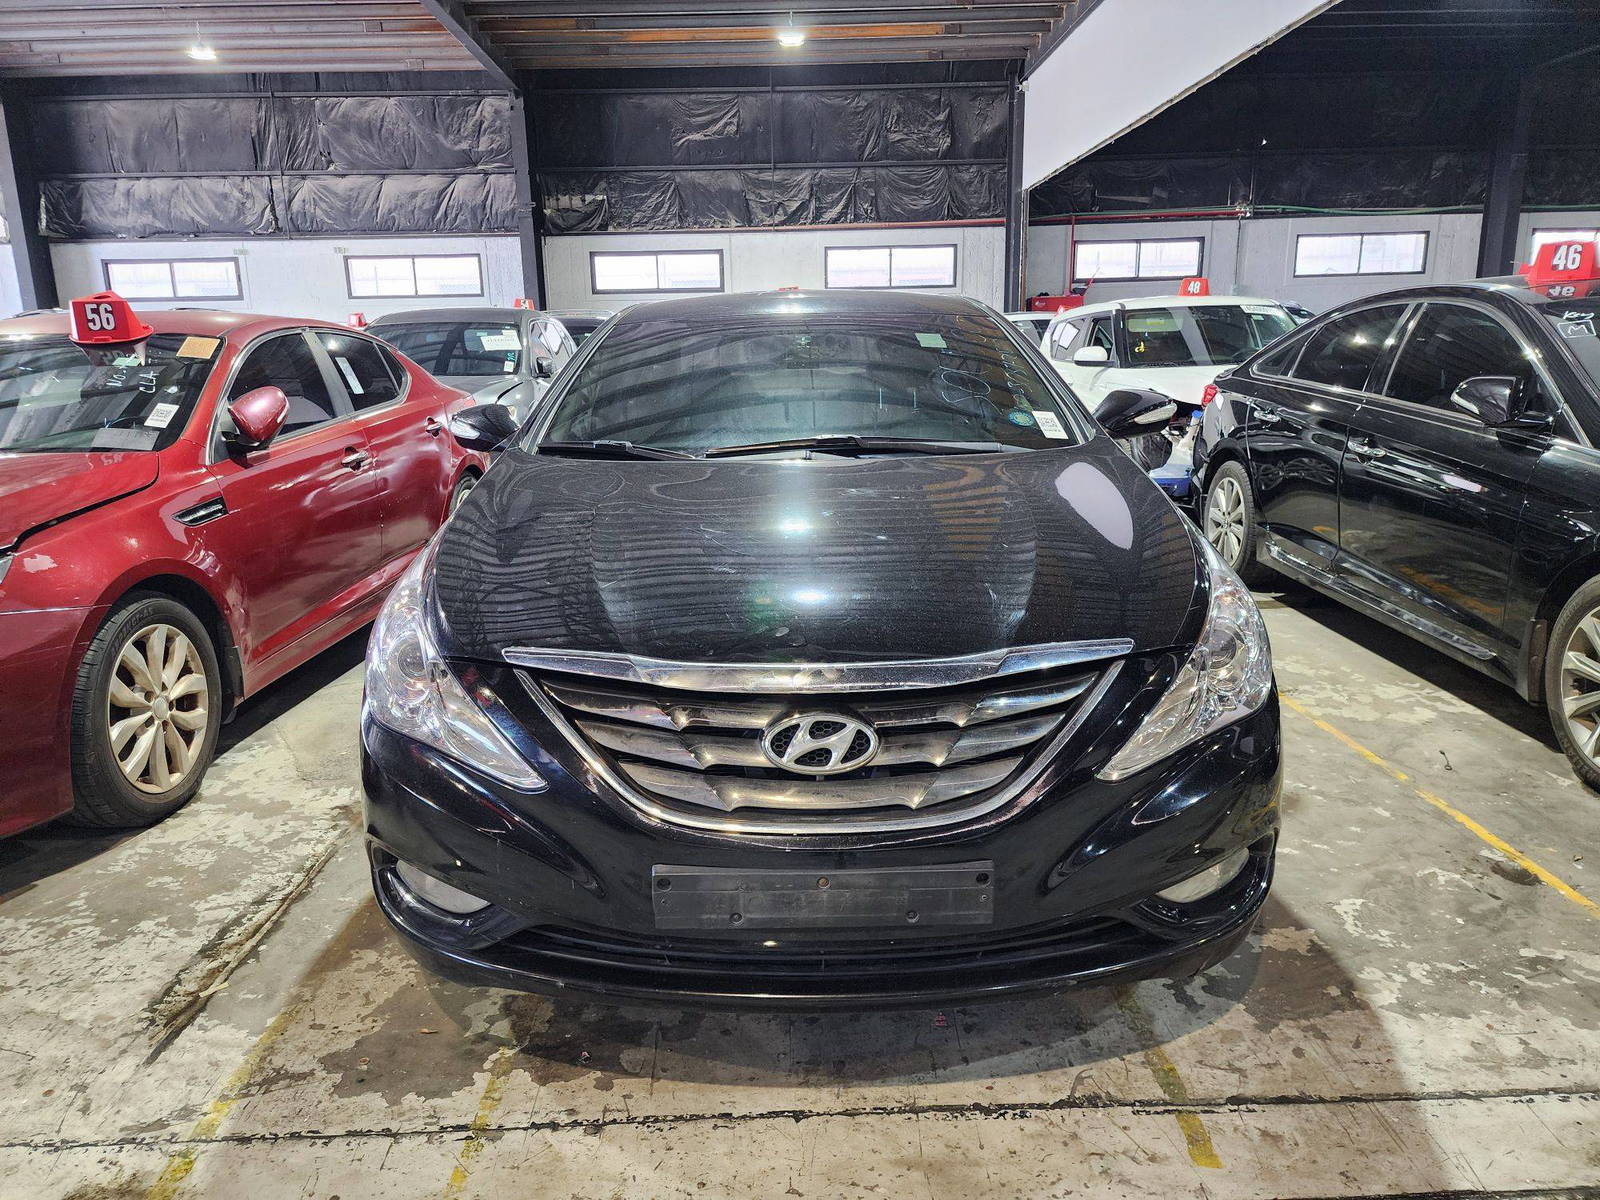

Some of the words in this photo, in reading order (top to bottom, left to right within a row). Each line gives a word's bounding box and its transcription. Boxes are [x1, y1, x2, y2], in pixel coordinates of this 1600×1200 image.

[1552, 244, 1583, 271] 46
[1187, 280, 1202, 294] 48
[84, 303, 116, 331] 56
